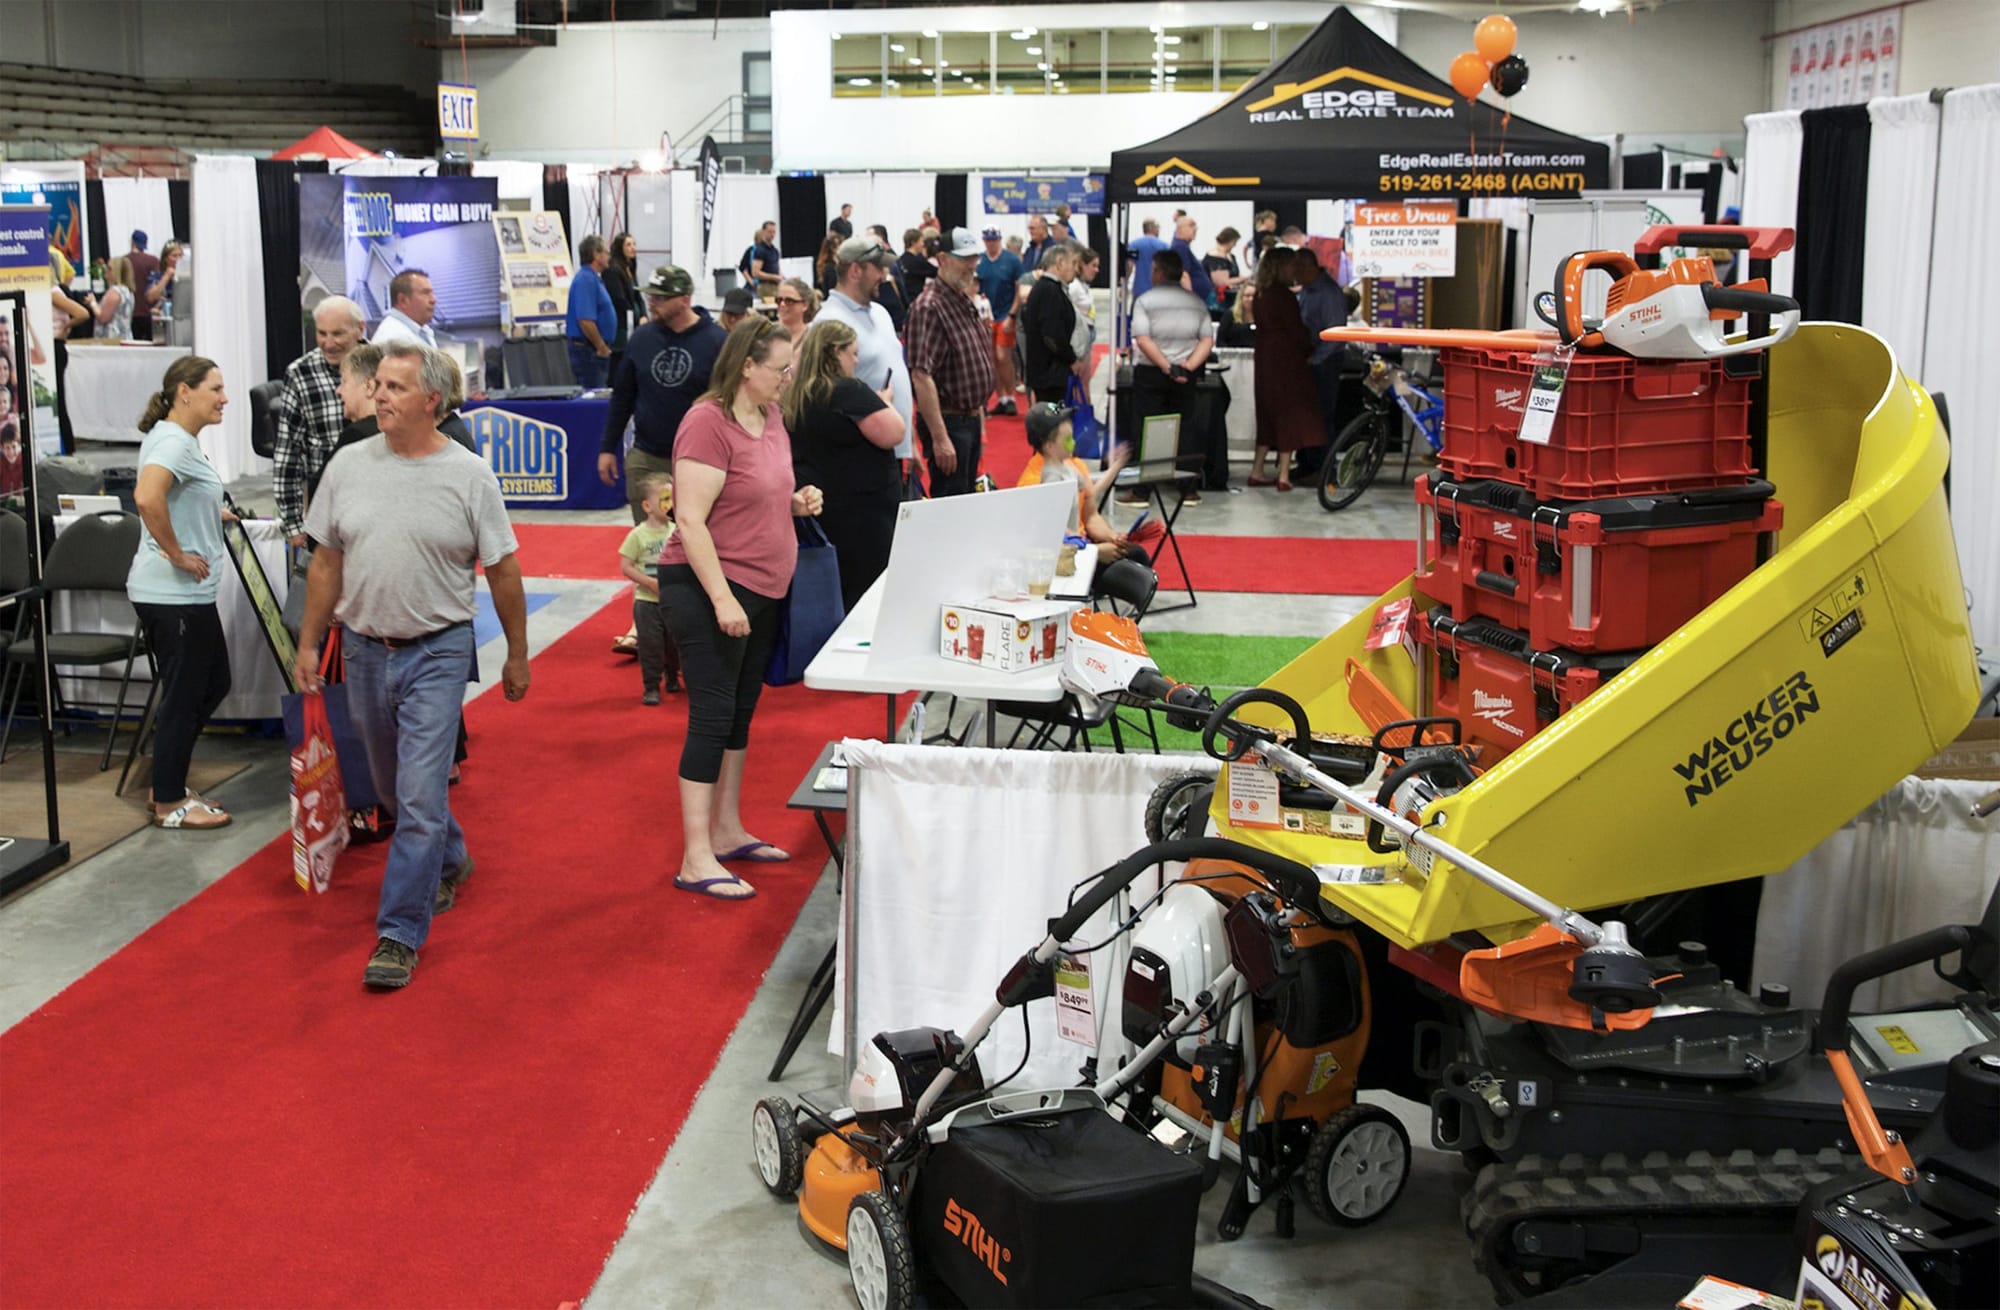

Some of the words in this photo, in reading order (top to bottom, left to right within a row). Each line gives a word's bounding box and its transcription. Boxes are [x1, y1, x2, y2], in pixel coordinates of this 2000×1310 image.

[1302, 90, 1398, 108] EDGE
[442, 94, 473, 129] EXIT
[1250, 110, 1303, 123] REAL
[1308, 107, 1386, 119] ESTATE
[1392, 106, 1454, 119] TEAM
[1379, 153, 1585, 171] EdgeRealEstateTeam.com
[1156, 174, 1194, 187] EDGE
[1379, 174, 1507, 192] 519-261-2468
[1511, 173, 1586, 193] (AGNT)
[1137, 187, 1159, 196] REAL
[1160, 186, 1191, 195] ESTATE
[1192, 185, 1217, 195] TEAM
[394, 203, 431, 222] MONEY
[432, 203, 459, 222] CAN
[460, 203, 493, 222] BUY!
[1360, 207, 1401, 225] Free
[1405, 205, 1450, 224] Draw
[0, 229, 13, 240] est
[14, 227, 45, 240] control
[1369, 228, 1395, 237] ENTER
[1397, 228, 1415, 236] FOR
[1417, 228, 1440, 236] YOUR
[1370, 239, 1404, 247] CHANCE
[1629, 304, 1661, 323] STIHL
[501, 478, 553, 494] SYSTEMS
[1000, 621, 1012, 671] FLARE
[1085, 656, 1109, 675] STIHL
[1472, 689, 1513, 710] Milwaukee
[1672, 670, 1813, 781] WACKER
[1684, 690, 1821, 808] NEUSON
